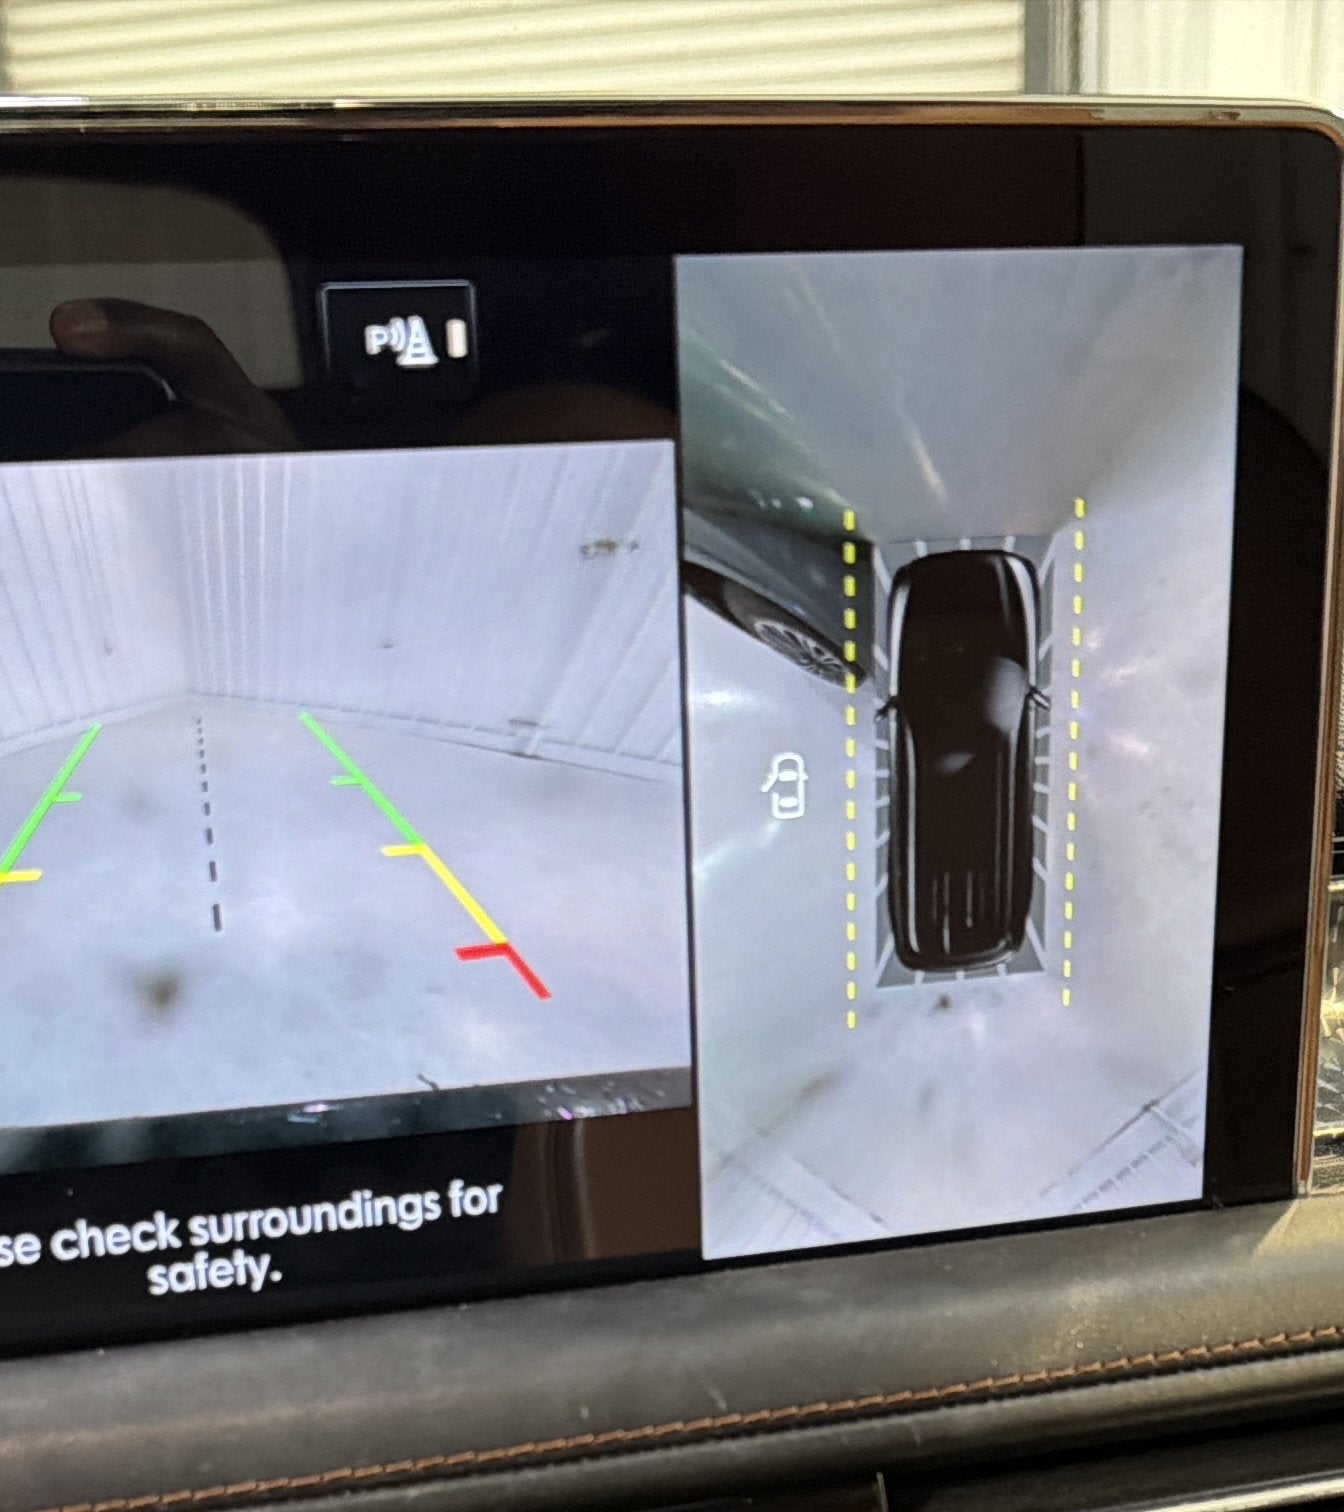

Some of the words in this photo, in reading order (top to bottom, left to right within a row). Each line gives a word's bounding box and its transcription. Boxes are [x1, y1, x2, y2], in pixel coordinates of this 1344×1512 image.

[51, 1212, 180, 1261] check
[188, 1190, 442, 1248] surroundings
[448, 1179, 503, 1217] for
[147, 1252, 282, 1295] safety.
